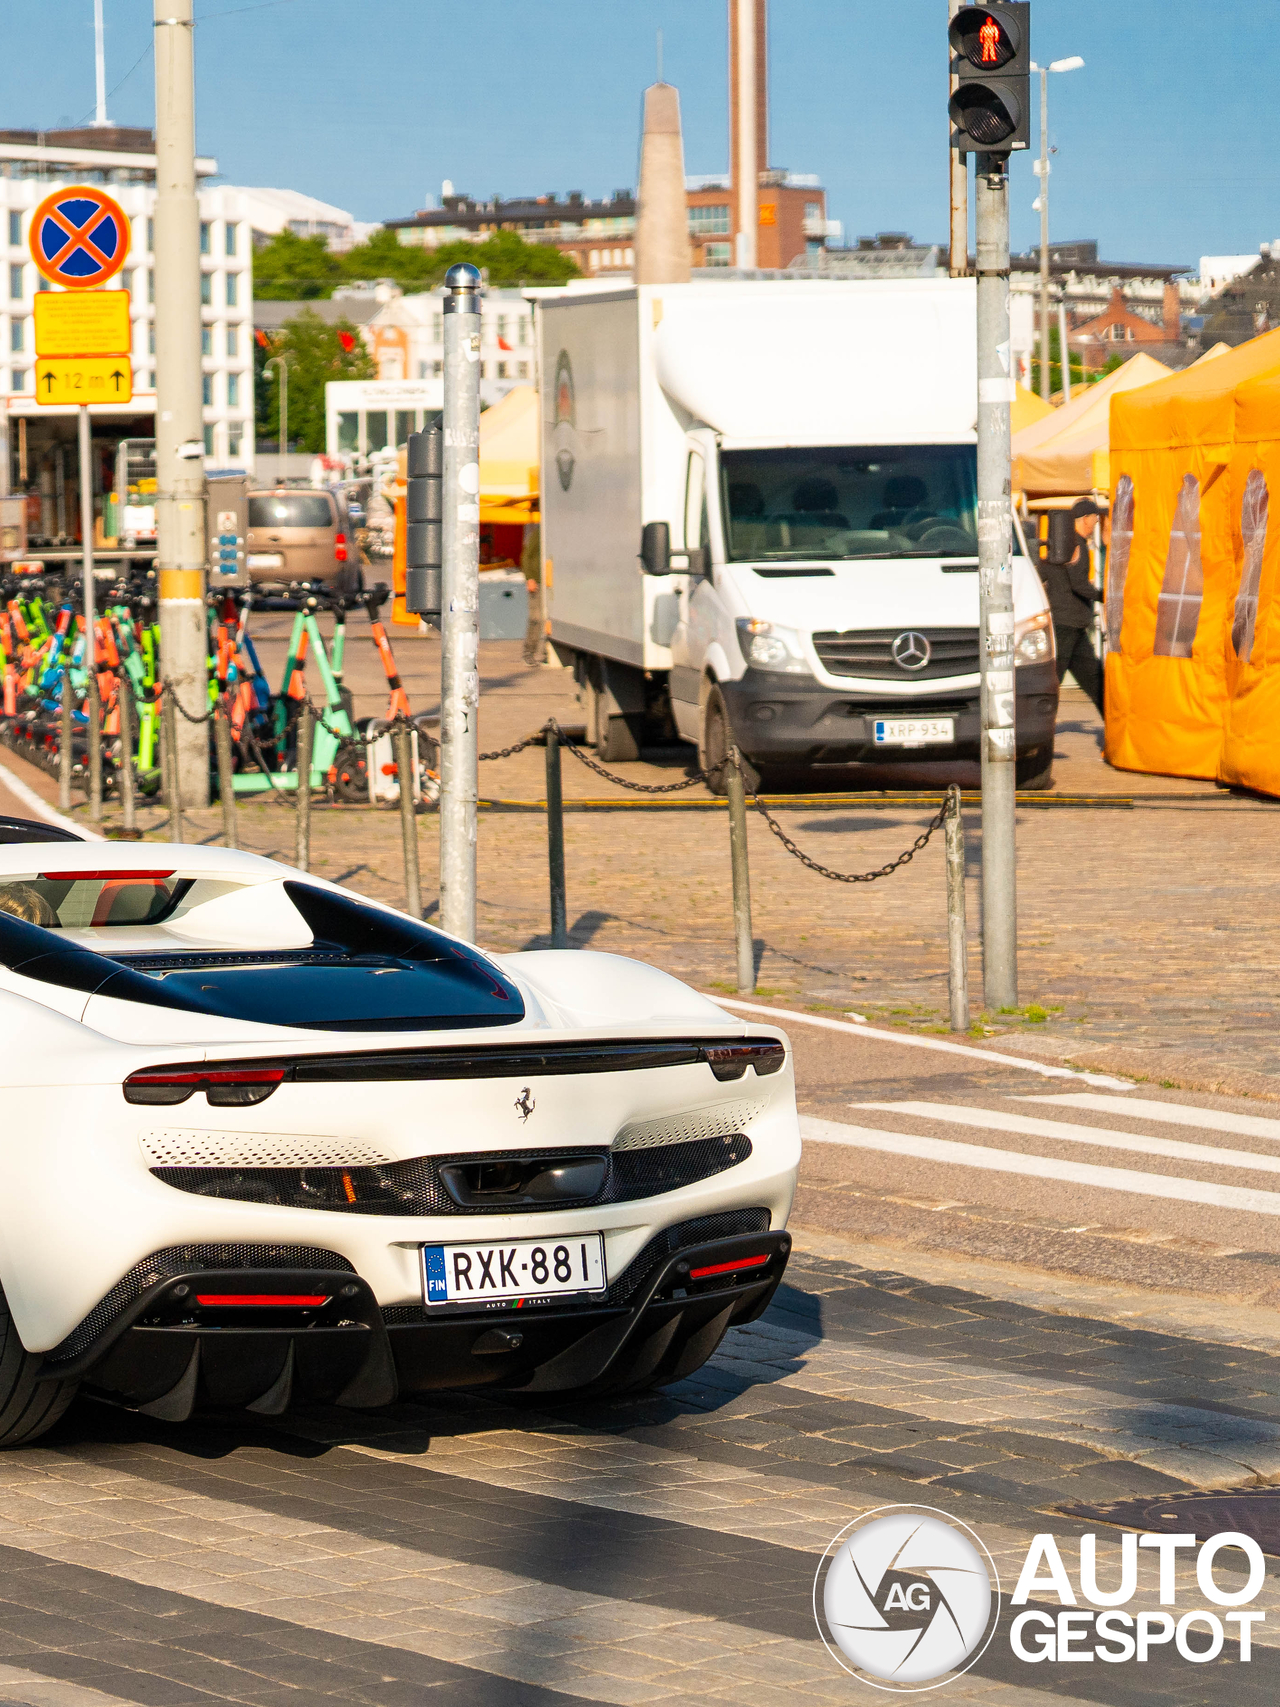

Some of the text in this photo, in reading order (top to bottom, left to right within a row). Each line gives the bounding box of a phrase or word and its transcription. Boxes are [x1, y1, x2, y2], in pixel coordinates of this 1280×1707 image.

[64, 372, 83, 389] 12
[888, 723, 948, 737] XRP-934
[428, 1243, 589, 1292] FIN RXK-881
